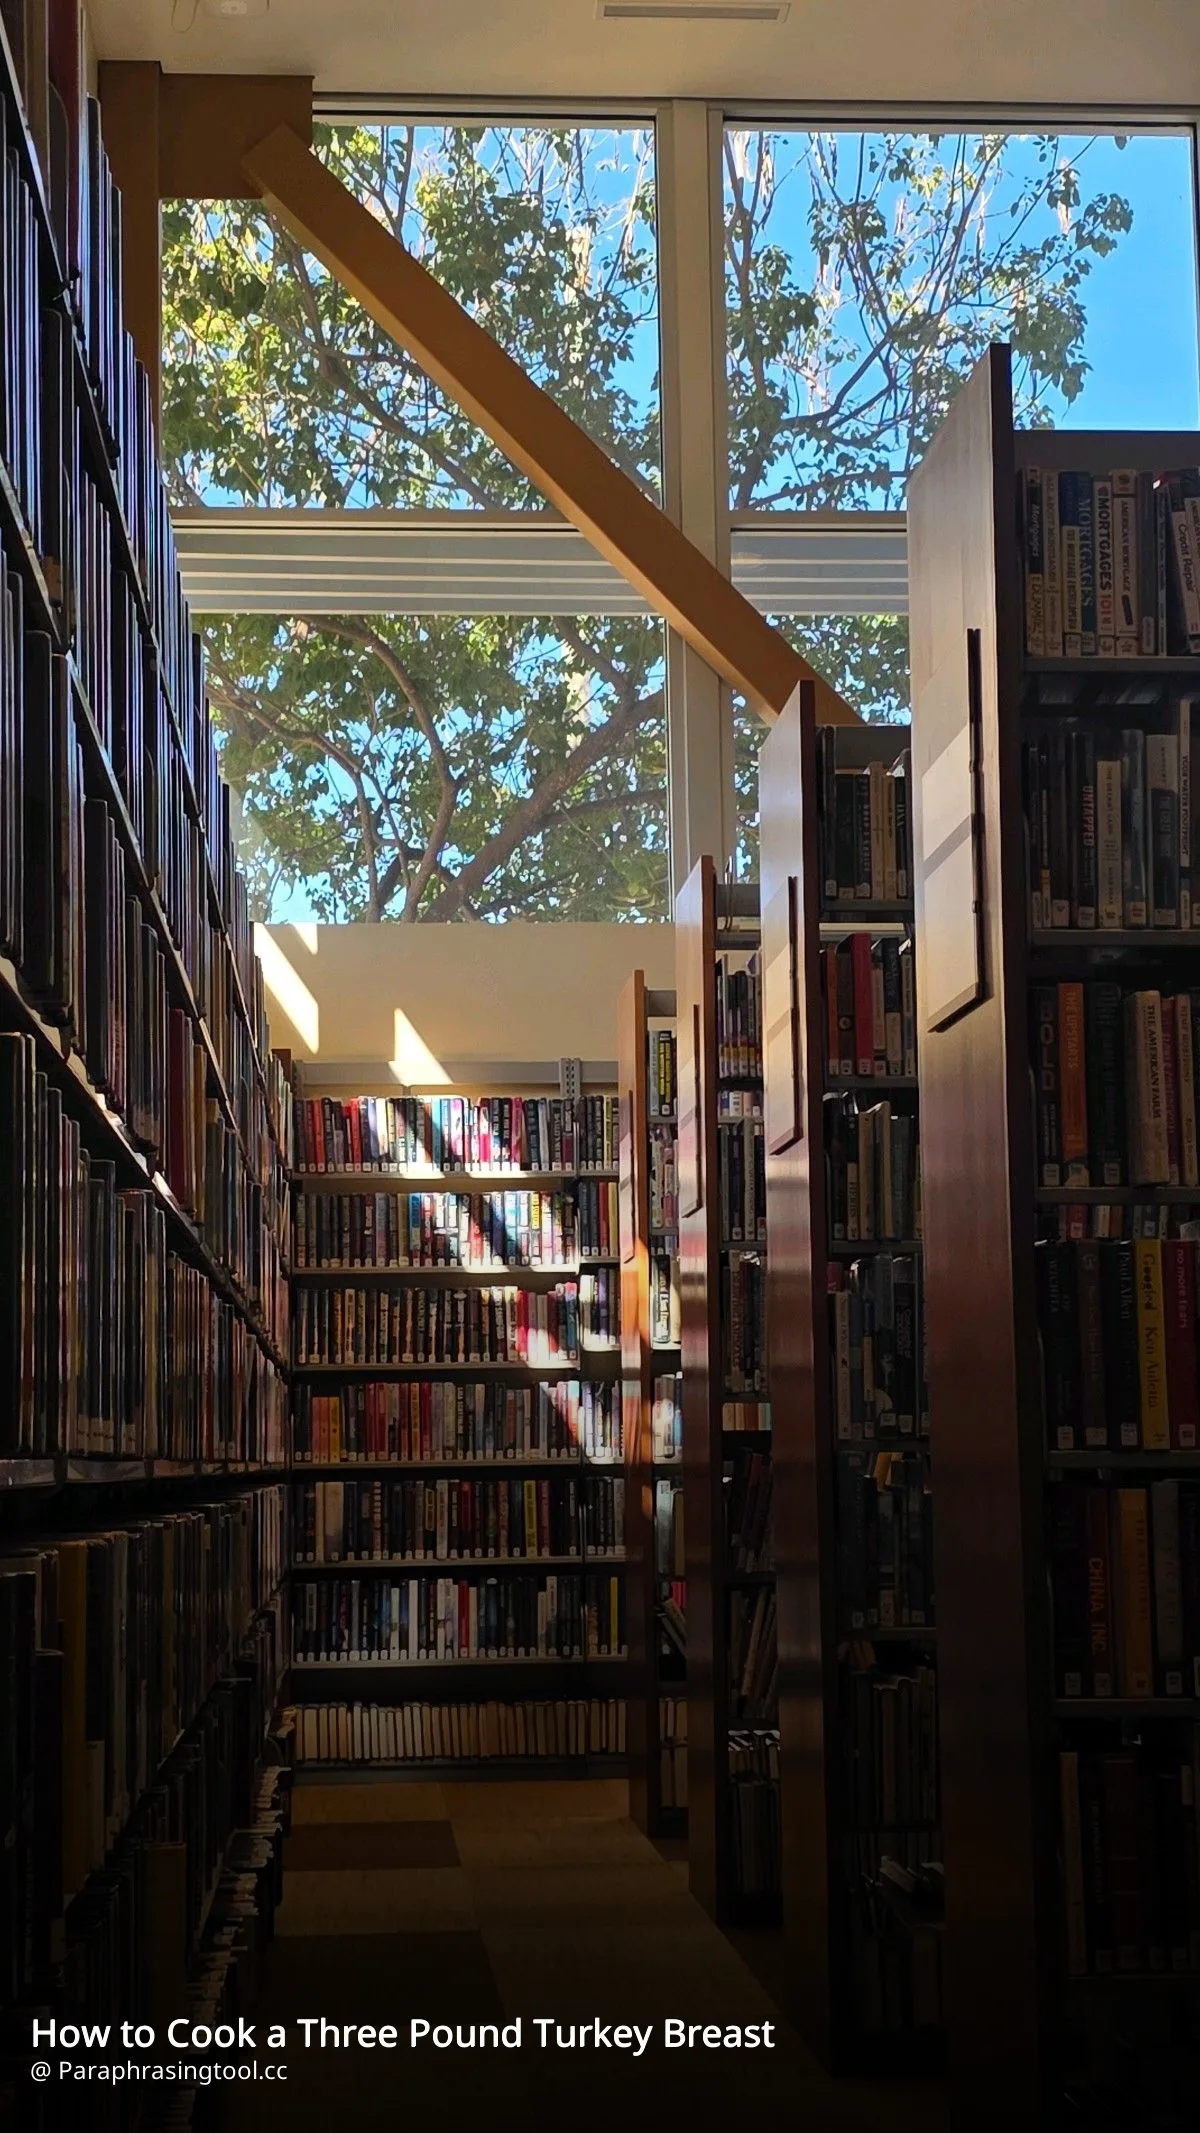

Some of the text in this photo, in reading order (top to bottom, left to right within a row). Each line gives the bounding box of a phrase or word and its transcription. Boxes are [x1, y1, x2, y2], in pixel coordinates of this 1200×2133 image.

[1028, 503, 1041, 557] Mortgages
[1078, 497, 1093, 607] MORTGAGES
[1097, 497, 1112, 590] MORTGAGES
[1178, 523, 1196, 593] Credit Repair
[1082, 785, 1095, 847] UNTAPPED
[1066, 991, 1077, 1012] THE
[1067, 1015, 1080, 1069] UPSTARTS
[1147, 1005, 1161, 1119] THE AMERICAN FARM
[1048, 1259, 1058, 1313] WICHITA
[1117, 1250, 1131, 1281] Paul
[1141, 1253, 1157, 1311] Googled
[1176, 1249, 1189, 1329] no more tears
[1119, 1283, 1133, 1320] Allen
[1144, 1326, 1159, 1408] Ken Auletta
[1088, 1557, 1105, 1613] CHINA
